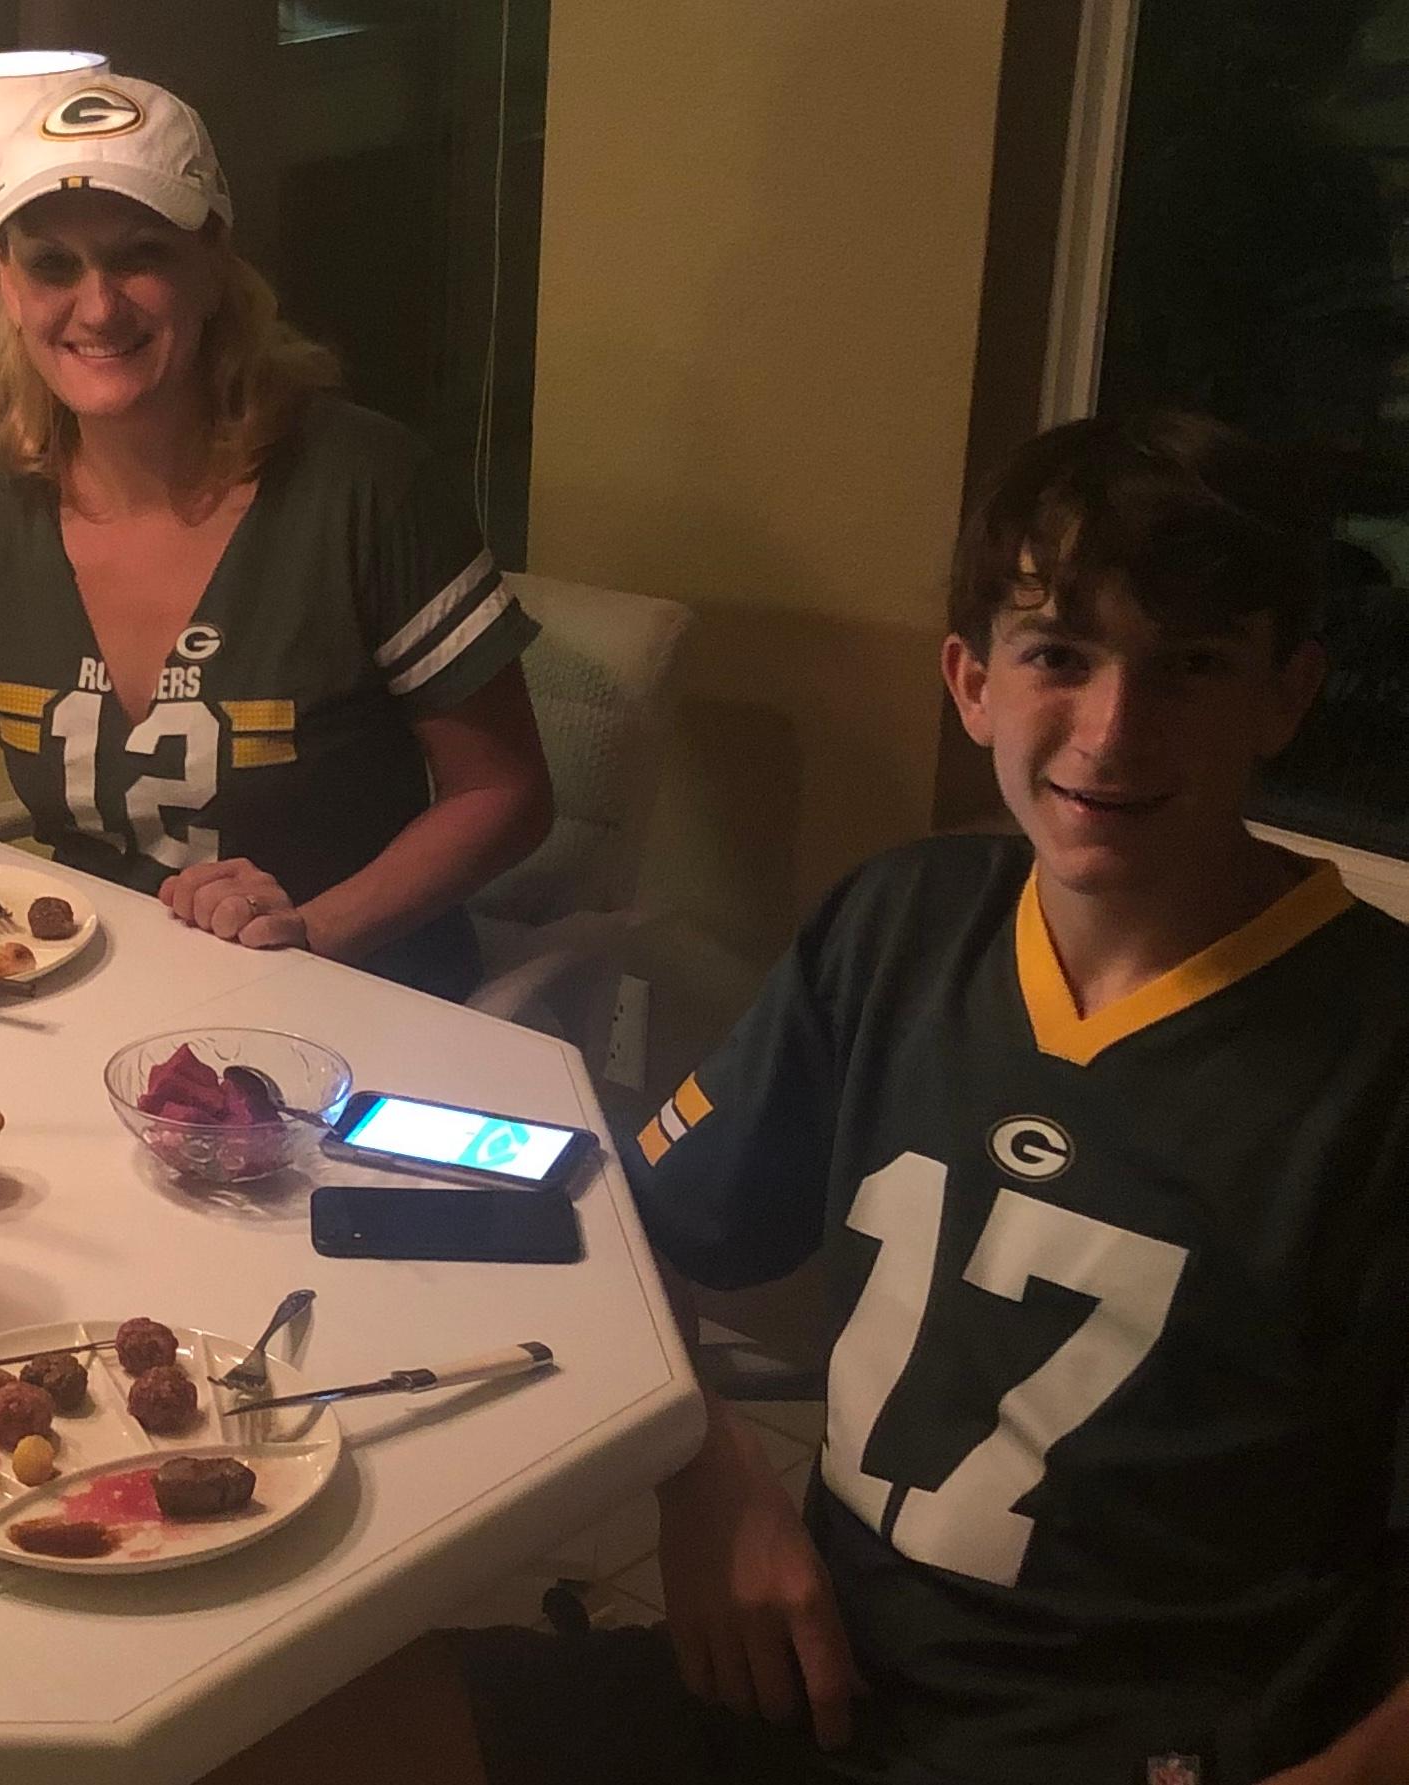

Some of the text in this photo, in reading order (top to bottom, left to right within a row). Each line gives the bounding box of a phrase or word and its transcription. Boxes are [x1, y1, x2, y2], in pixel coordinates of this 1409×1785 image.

[43, 87, 141, 137] G
[175, 625, 222, 661] G
[51, 691, 220, 869] 12
[991, 1118, 1071, 1179] G
[821, 1151, 1190, 1588] 17
